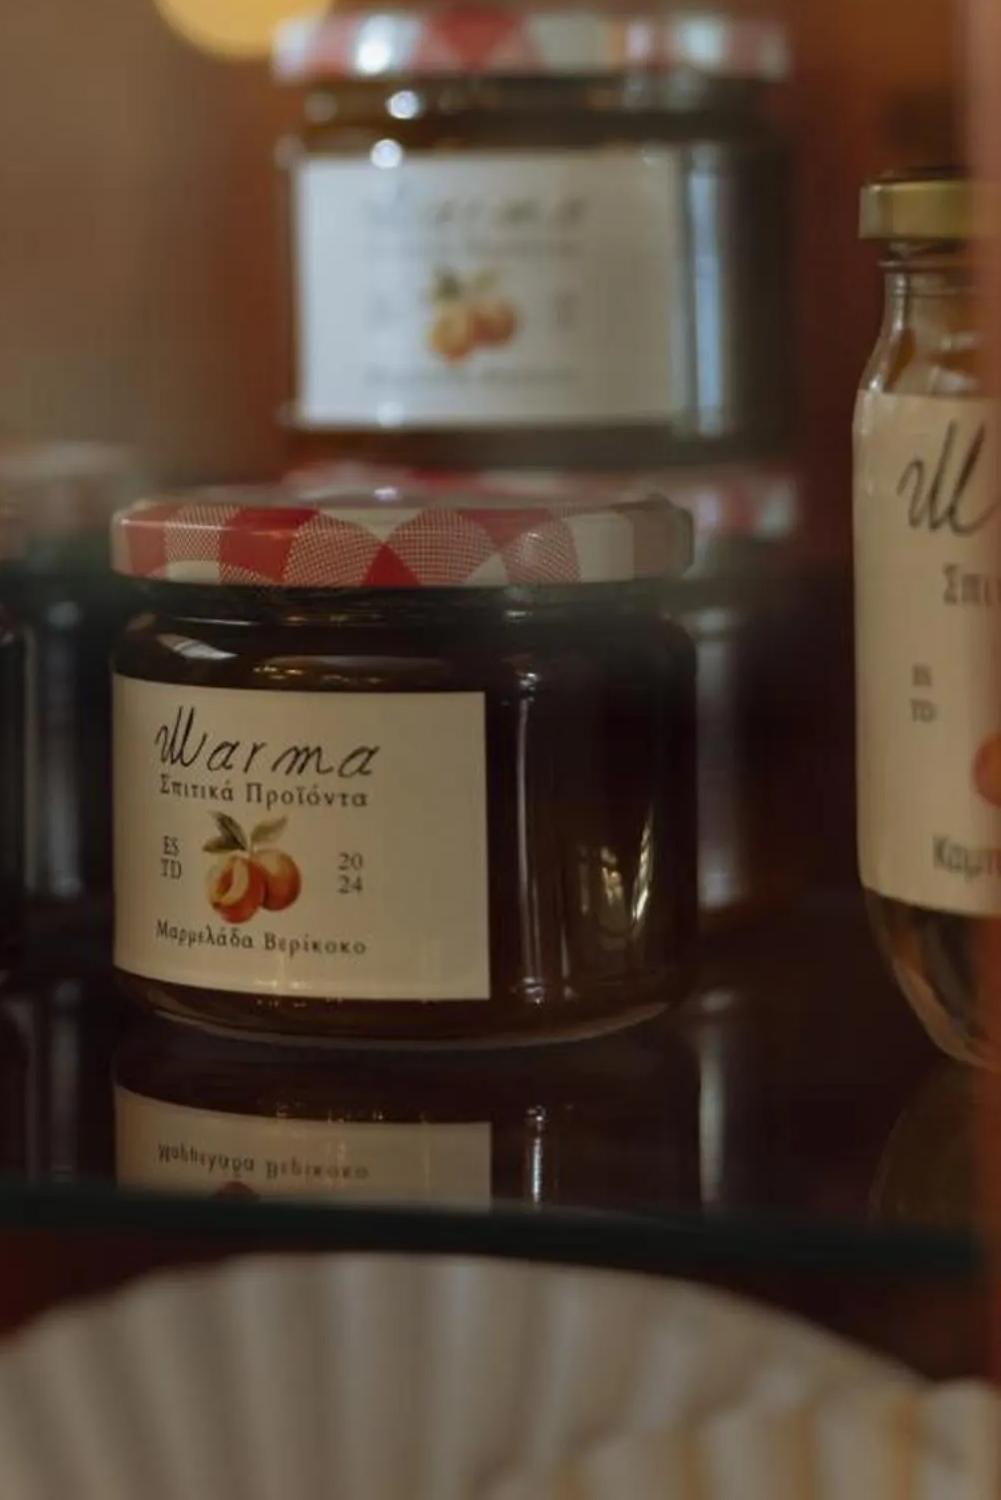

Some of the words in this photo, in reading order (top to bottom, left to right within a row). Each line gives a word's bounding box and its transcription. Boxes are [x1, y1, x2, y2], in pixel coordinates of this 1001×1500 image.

[154, 705, 381, 778] Warma
[159, 773, 234, 803] Σπιτικά
[245, 781, 369, 811] Προϊόντα
[162, 835, 180, 856] ES
[160, 858, 183, 880] TD
[337, 852, 364, 871] 20
[337, 876, 364, 895] 24
[155, 919, 254, 951] Μαρμελάδα
[263, 932, 368, 957] Βερίκοκο
